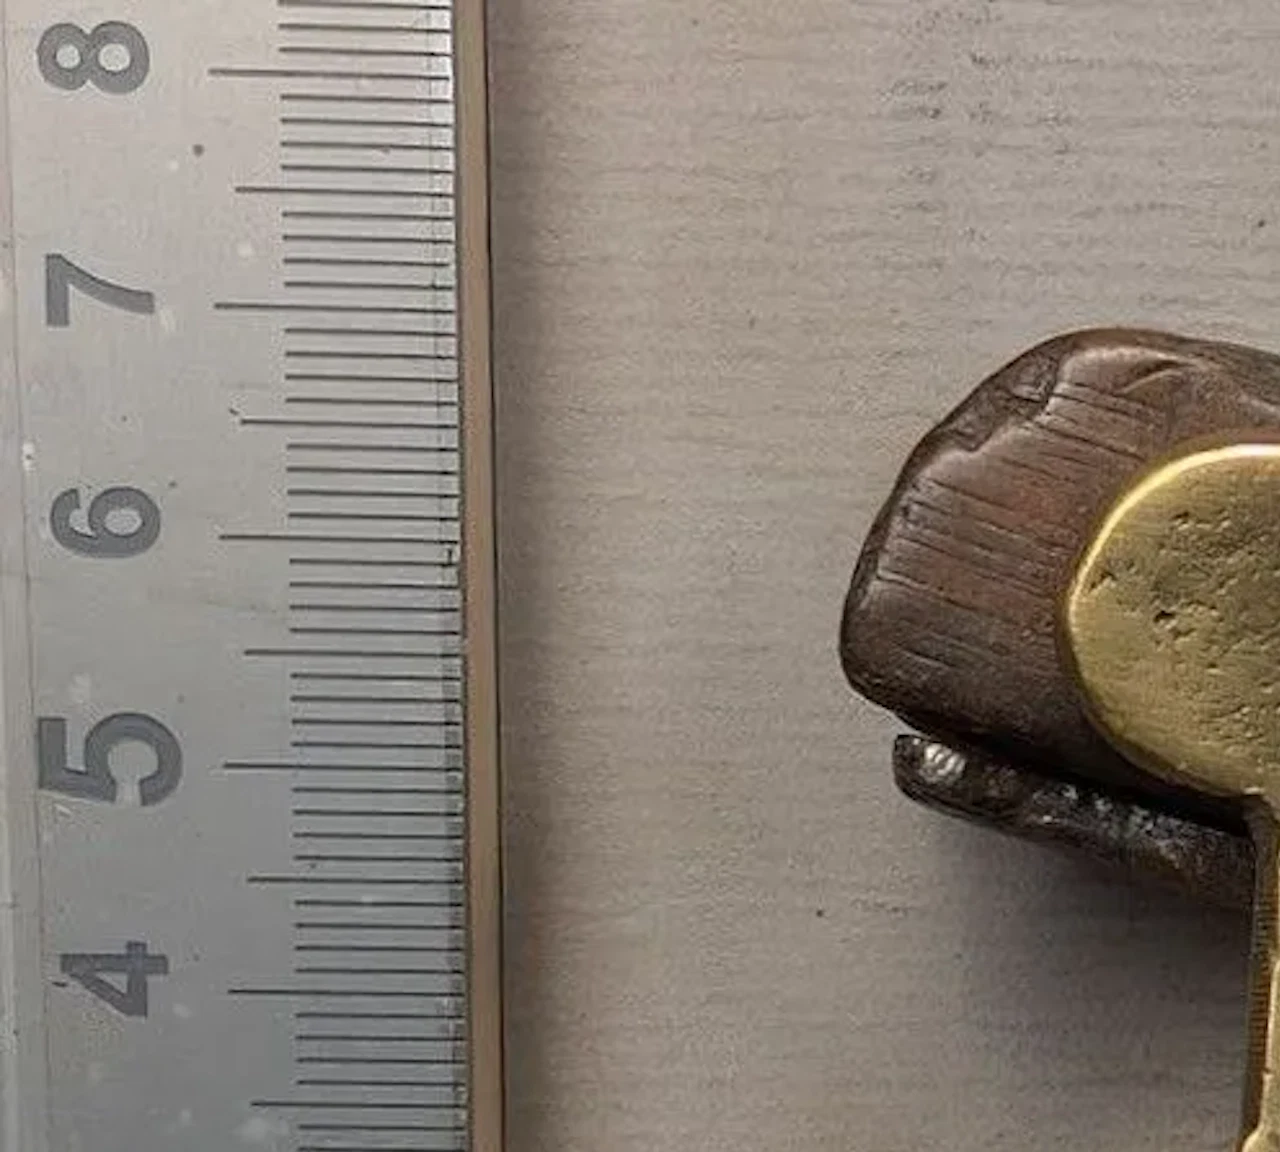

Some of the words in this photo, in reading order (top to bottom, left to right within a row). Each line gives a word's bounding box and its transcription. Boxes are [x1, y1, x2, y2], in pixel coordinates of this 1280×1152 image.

[36, 20, 151, 95] 8
[45, 253, 156, 328] 7
[49, 485, 162, 560] 6
[37, 712, 184, 808] 5
[60, 941, 169, 1017] 4
